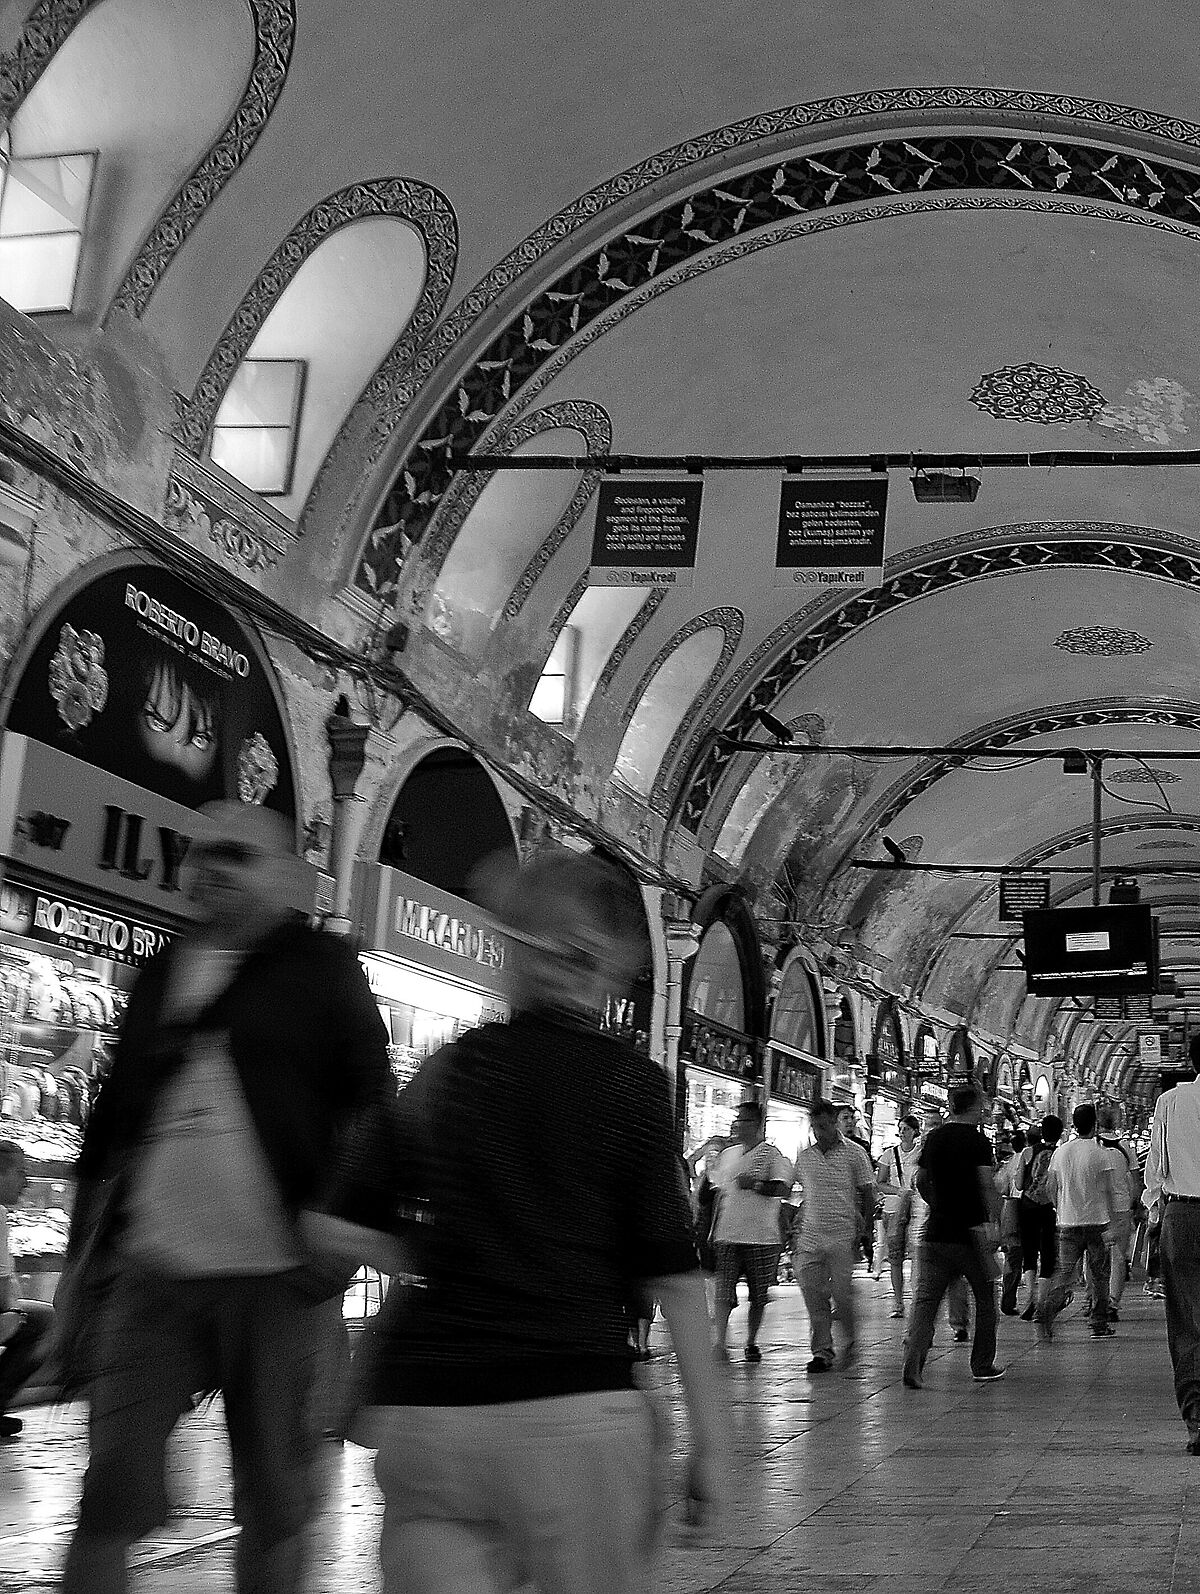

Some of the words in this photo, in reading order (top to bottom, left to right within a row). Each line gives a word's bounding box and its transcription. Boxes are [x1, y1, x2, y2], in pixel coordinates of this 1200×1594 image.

[124, 582, 200, 647] ROBERTO
[200, 630, 251, 678] BRAVO
[33, 896, 130, 952] ROBERTO
